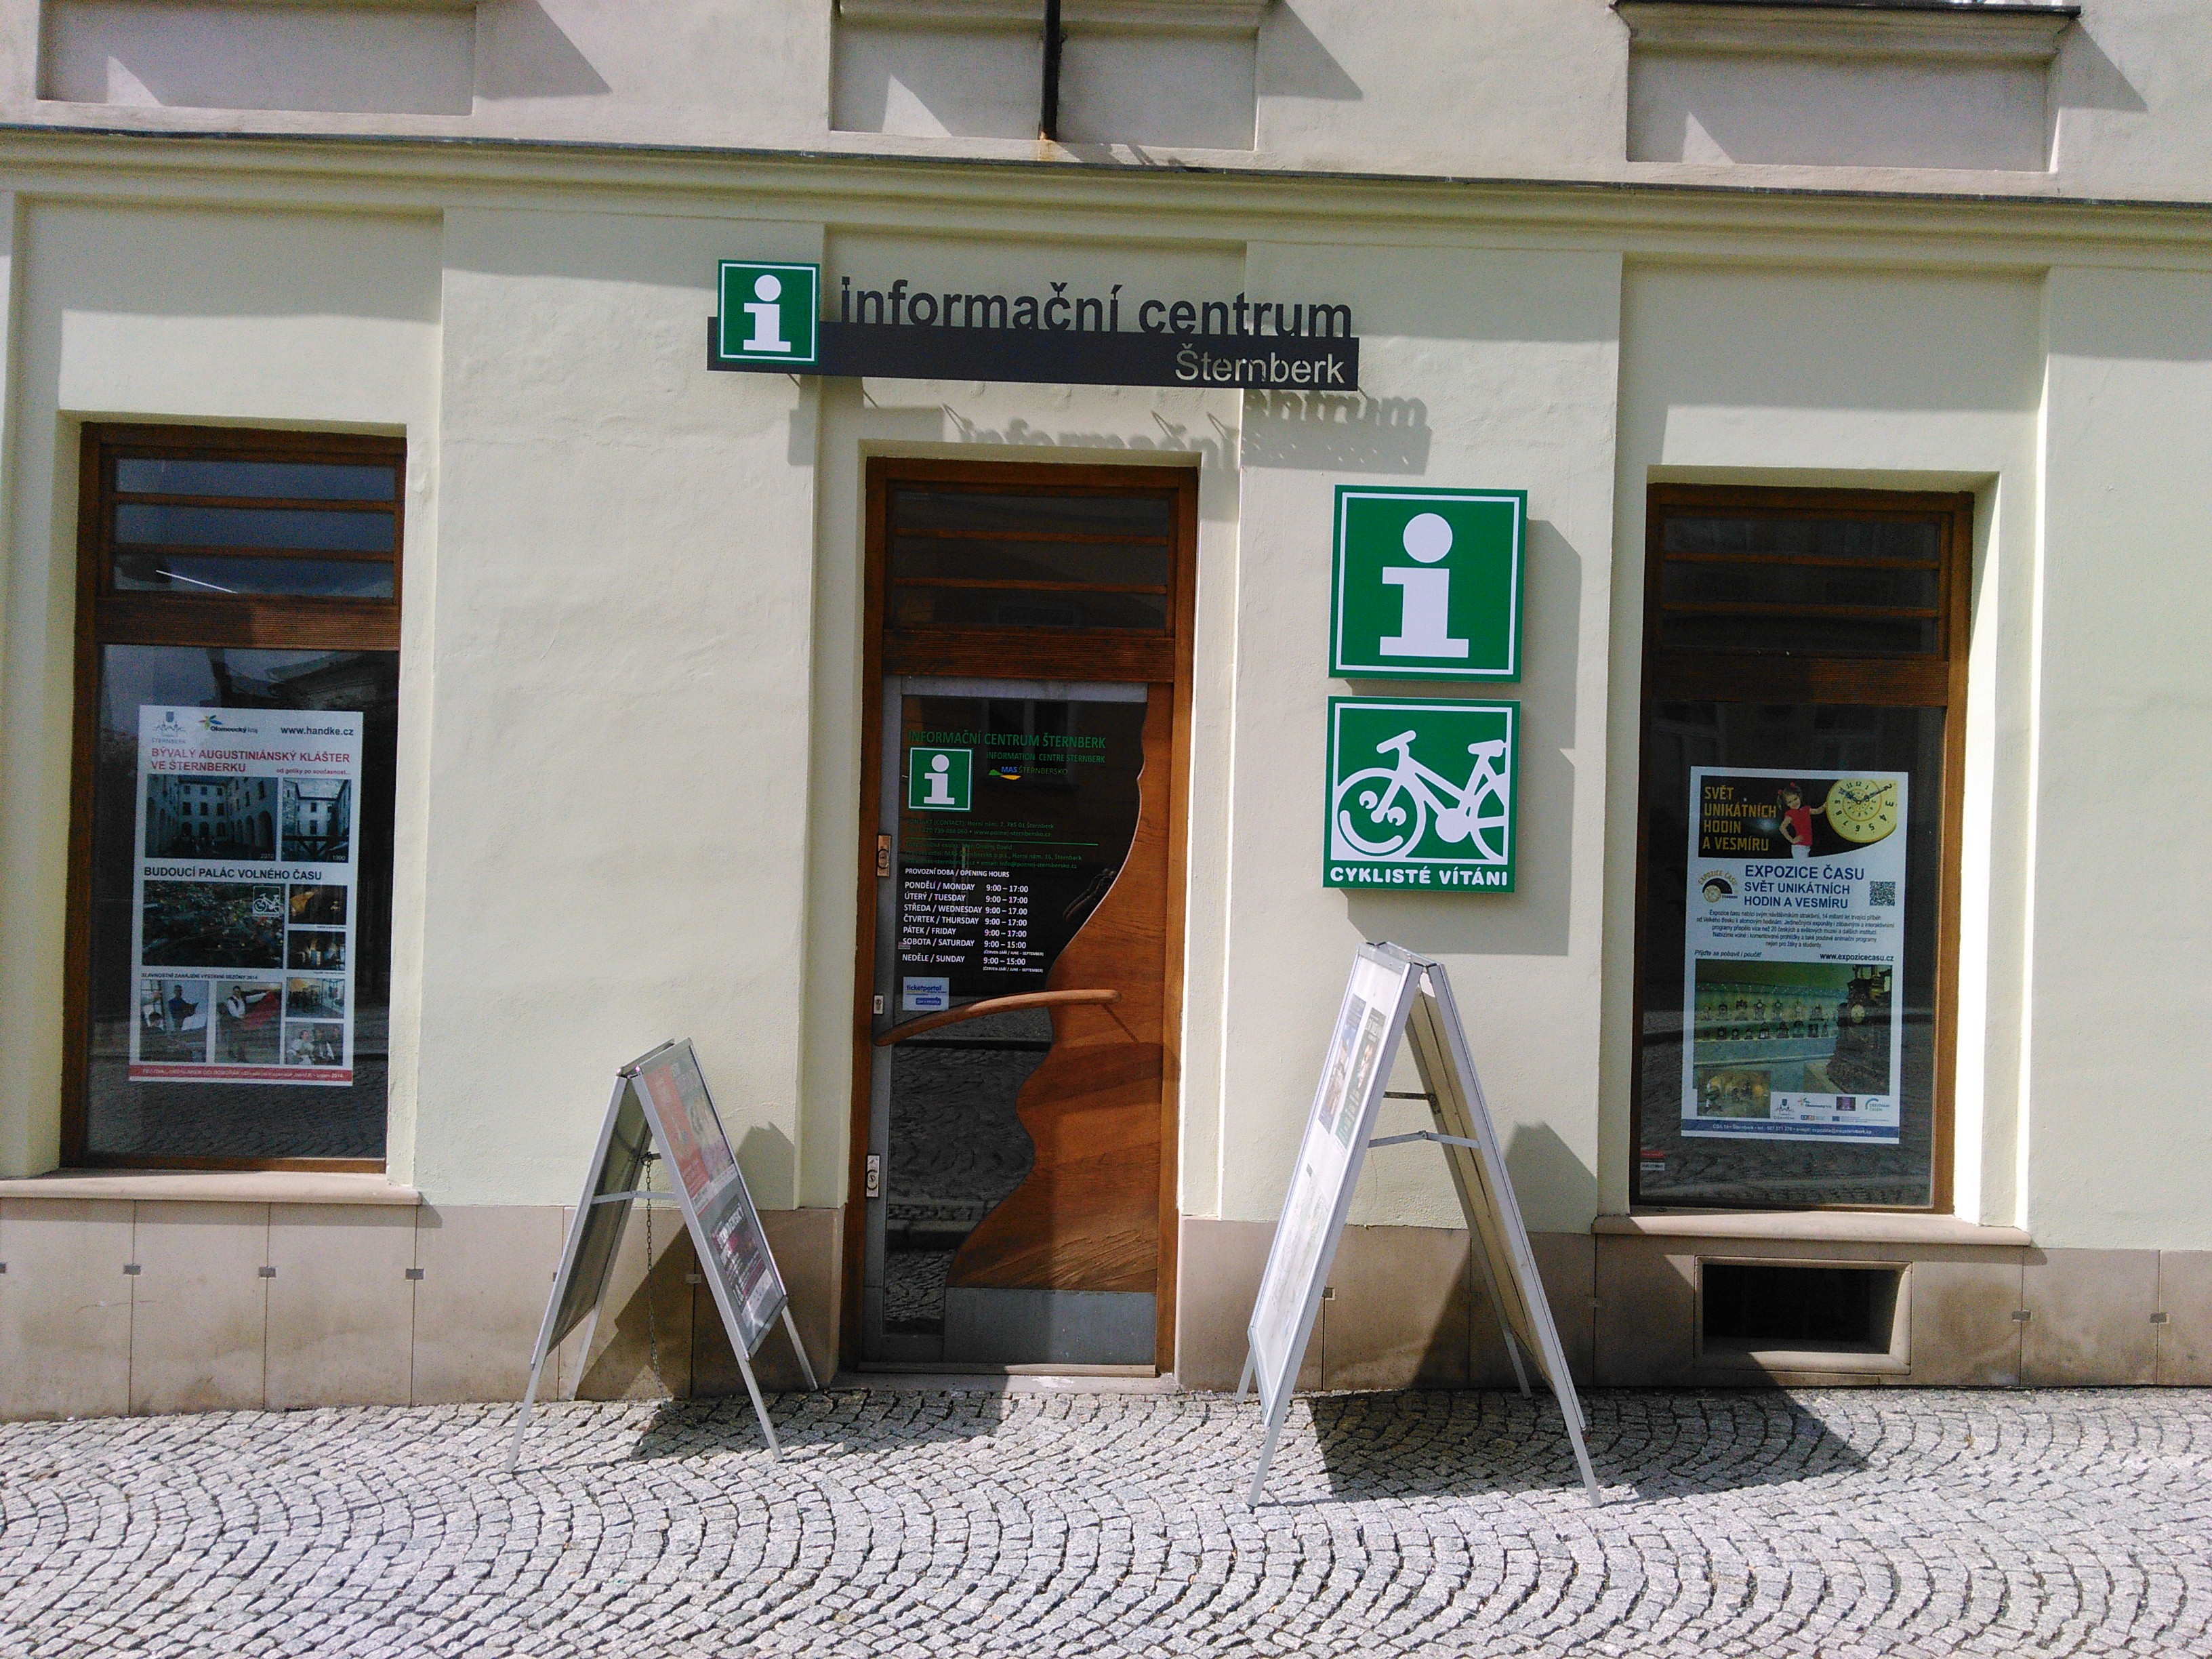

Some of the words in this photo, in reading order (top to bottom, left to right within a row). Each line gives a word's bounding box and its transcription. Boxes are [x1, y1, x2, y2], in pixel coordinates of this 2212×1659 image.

[840, 276, 1123, 333] informační
[1138, 291, 1353, 338] centrum
[1174, 343, 1346, 384] Šternberk
[281, 726, 354, 736] www.handke.cz
[908, 729, 982, 745] INFORMAČNÍ
[984, 733, 1040, 747] CENTRUM
[1042, 732, 1106, 749] ŠTERNBERK
[151, 747, 196, 758] BÝVALÝ
[199, 749, 296, 761] AUGUSTINIÁNSKÝ
[300, 750, 350, 762] KLÁŠTER
[987, 752, 1035, 760] INFORMATION
[1039, 753, 1065, 762] CENTRE
[1066, 754, 1105, 763] STERNBERK
[151, 760, 166, 769] VE
[169, 759, 245, 772] ŠTERNBERKU
[1019, 765, 1068, 775] ŠTERNBERSKO
[1704, 785, 1734, 800] SVĚT
[1704, 802, 1776, 818] UNIKÁTNÍCH
[1704, 819, 1741, 834] HODIN
[1702, 836, 1711, 850] A
[1715, 836, 1769, 851] VESMÍRU
[144, 865, 195, 877] BUDOUCÍ
[199, 866, 234, 878] PALÁC
[238, 867, 290, 880] VOLNÉHO
[293, 869, 321, 880] ČASU
[1330, 865, 1431, 884] CYKLISTÉ
[1439, 866, 1508, 886] VÍTÁNI
[1745, 865, 1818, 879] EXPOZICE
[1823, 864, 1864, 880] ČASU
[905, 880, 937, 889] PONDĚLÍ
[943, 882, 976, 890] MONDAY
[986, 884, 1002, 892] 9:00
[1744, 880, 1774, 893] SVĚT
[1778, 882, 1850, 895] UNIKÁTNÍCH
[904, 891, 928, 900] ÚTERÝ
[1008, 896, 1028, 904] 17:00
[1744, 896, 1781, 907] HODIN
[1784, 897, 1793, 907] A
[1795, 896, 1848, 909] VESMÍRU
[903, 902, 931, 912] STŘEDA
[938, 905, 983, 914] WEDNESDAY
[903, 914, 935, 923] ČTVRTEK
[941, 916, 979, 924] THURSDAY
[1008, 918, 1027, 926] 17:00
[903, 924, 924, 934] PÁTEK
[903, 937, 931, 945] SOBOTA
[937, 939, 975, 947] SATURDAY
[902, 952, 929, 962] NEDĚLE
[1820, 954, 1894, 962] www.expozicecasu.cz
[906, 984, 942, 993] ticketportal
